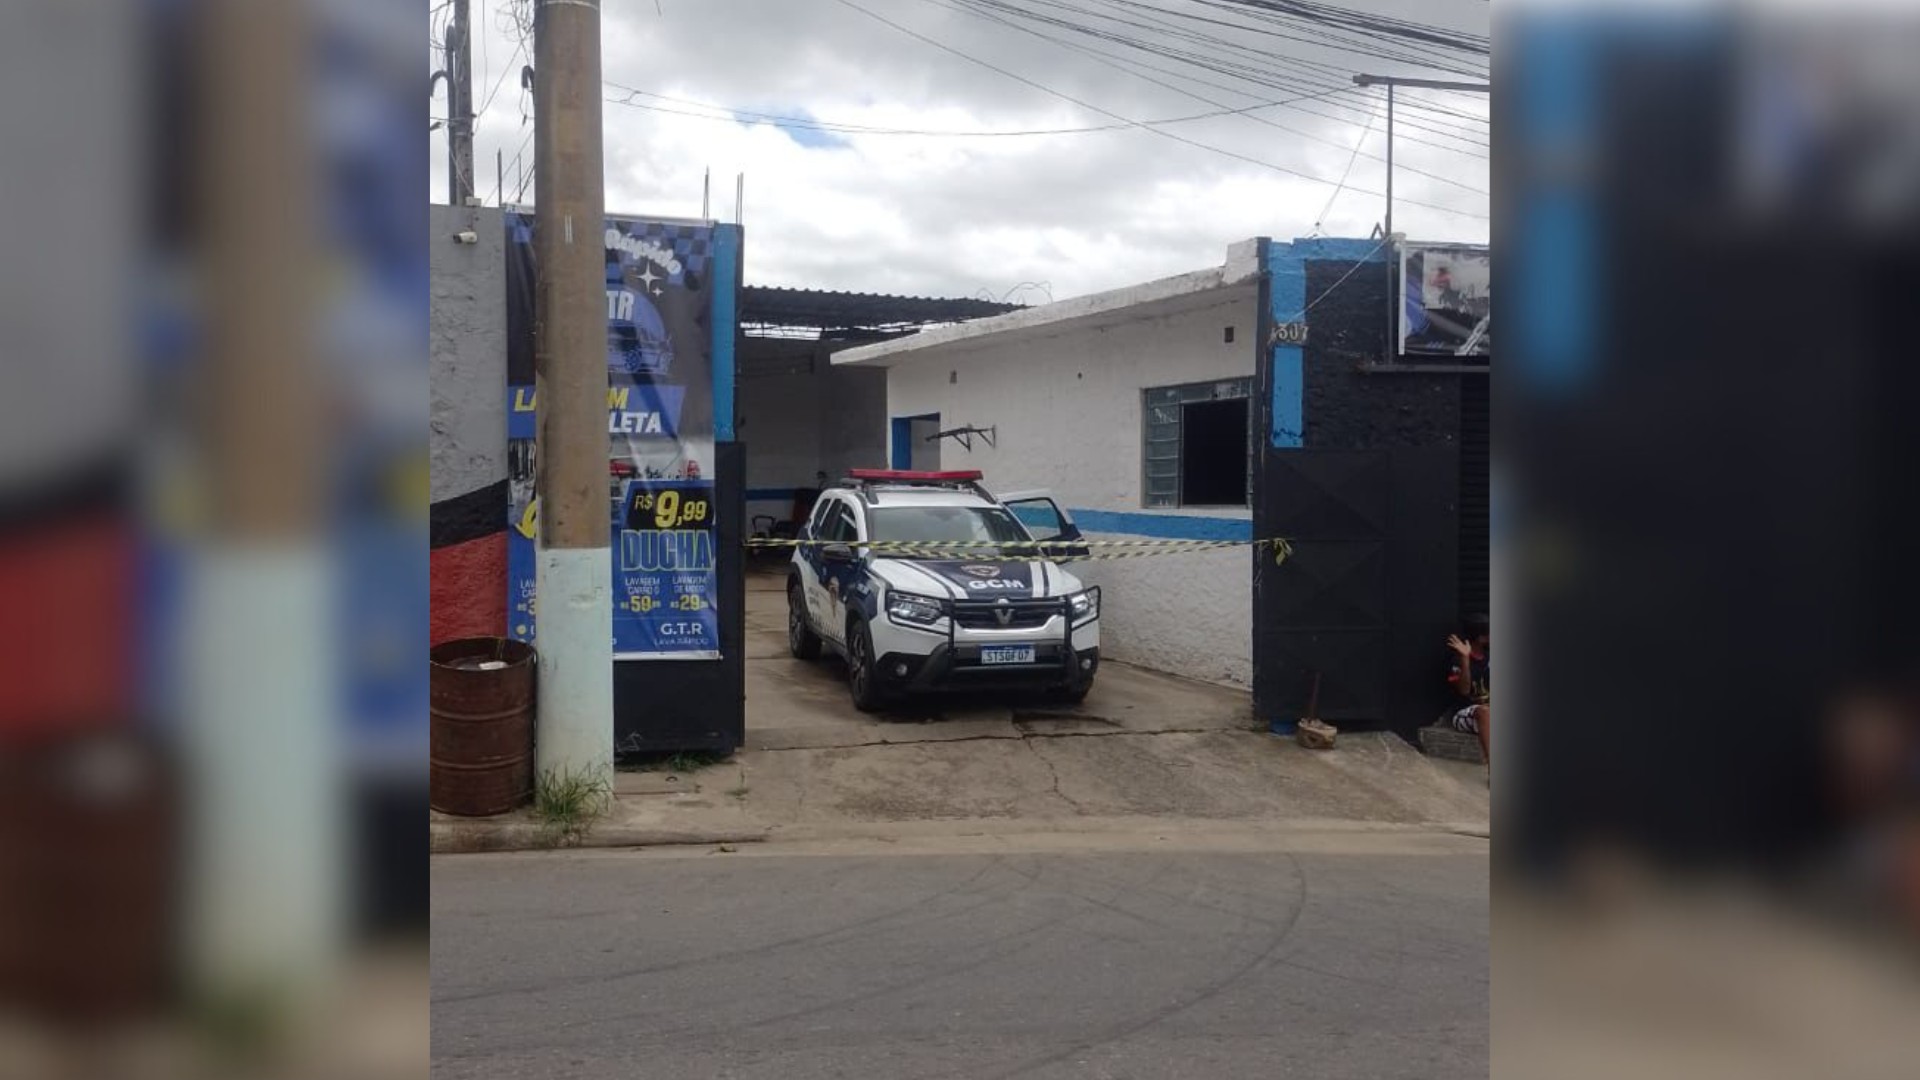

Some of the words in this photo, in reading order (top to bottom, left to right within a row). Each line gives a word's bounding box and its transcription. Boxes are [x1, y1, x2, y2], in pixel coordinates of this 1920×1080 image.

[606, 290, 634, 320] TR
[608, 412, 662, 433] LETA
[634, 493, 653, 510] R$
[621, 529, 713, 571] DUCHA
[968, 579, 1025, 590] GCM
[660, 622, 703, 635] G.T.R
